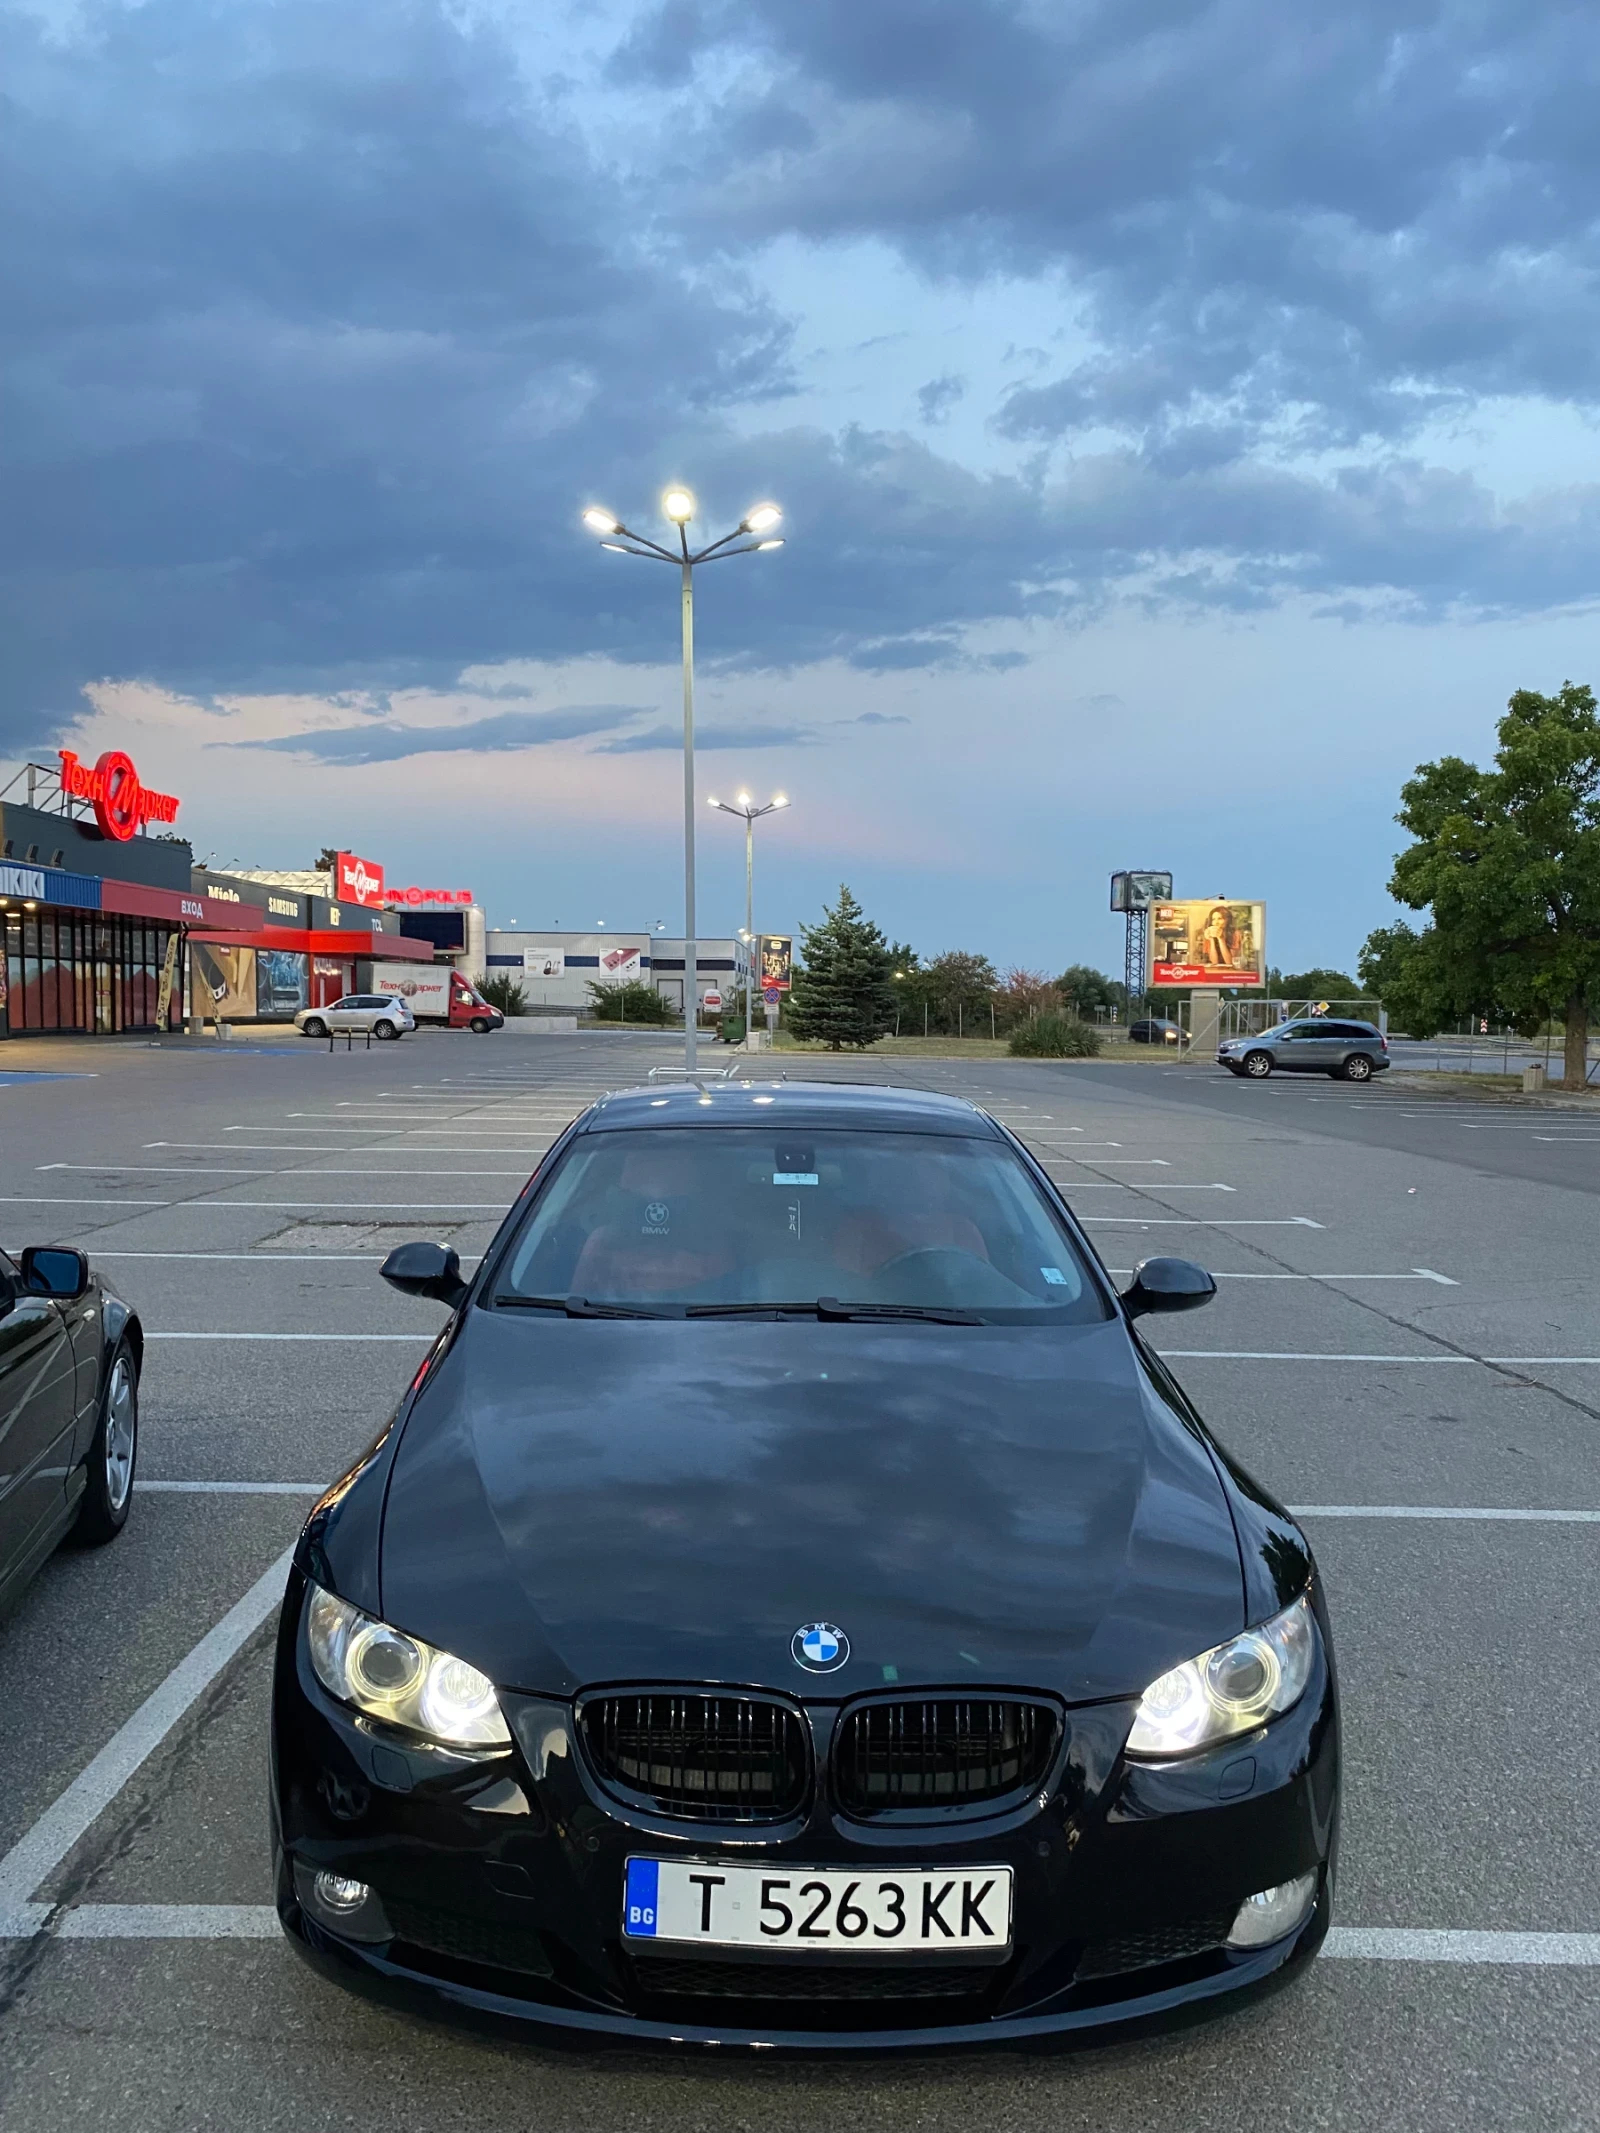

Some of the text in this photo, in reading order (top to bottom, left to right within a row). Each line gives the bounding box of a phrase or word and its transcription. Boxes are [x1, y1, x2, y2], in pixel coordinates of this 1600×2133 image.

[0, 866, 45, 899] IKIKI
[181, 900, 203, 919] ВХОД
[268, 896, 298, 918] SAMSUNG
[371, 918, 383, 932] TCL
[642, 1226, 670, 1235] BMW
[797, 1622, 844, 1639] BMW
[689, 1874, 725, 1932] T
[630, 1905, 655, 1926] BG
